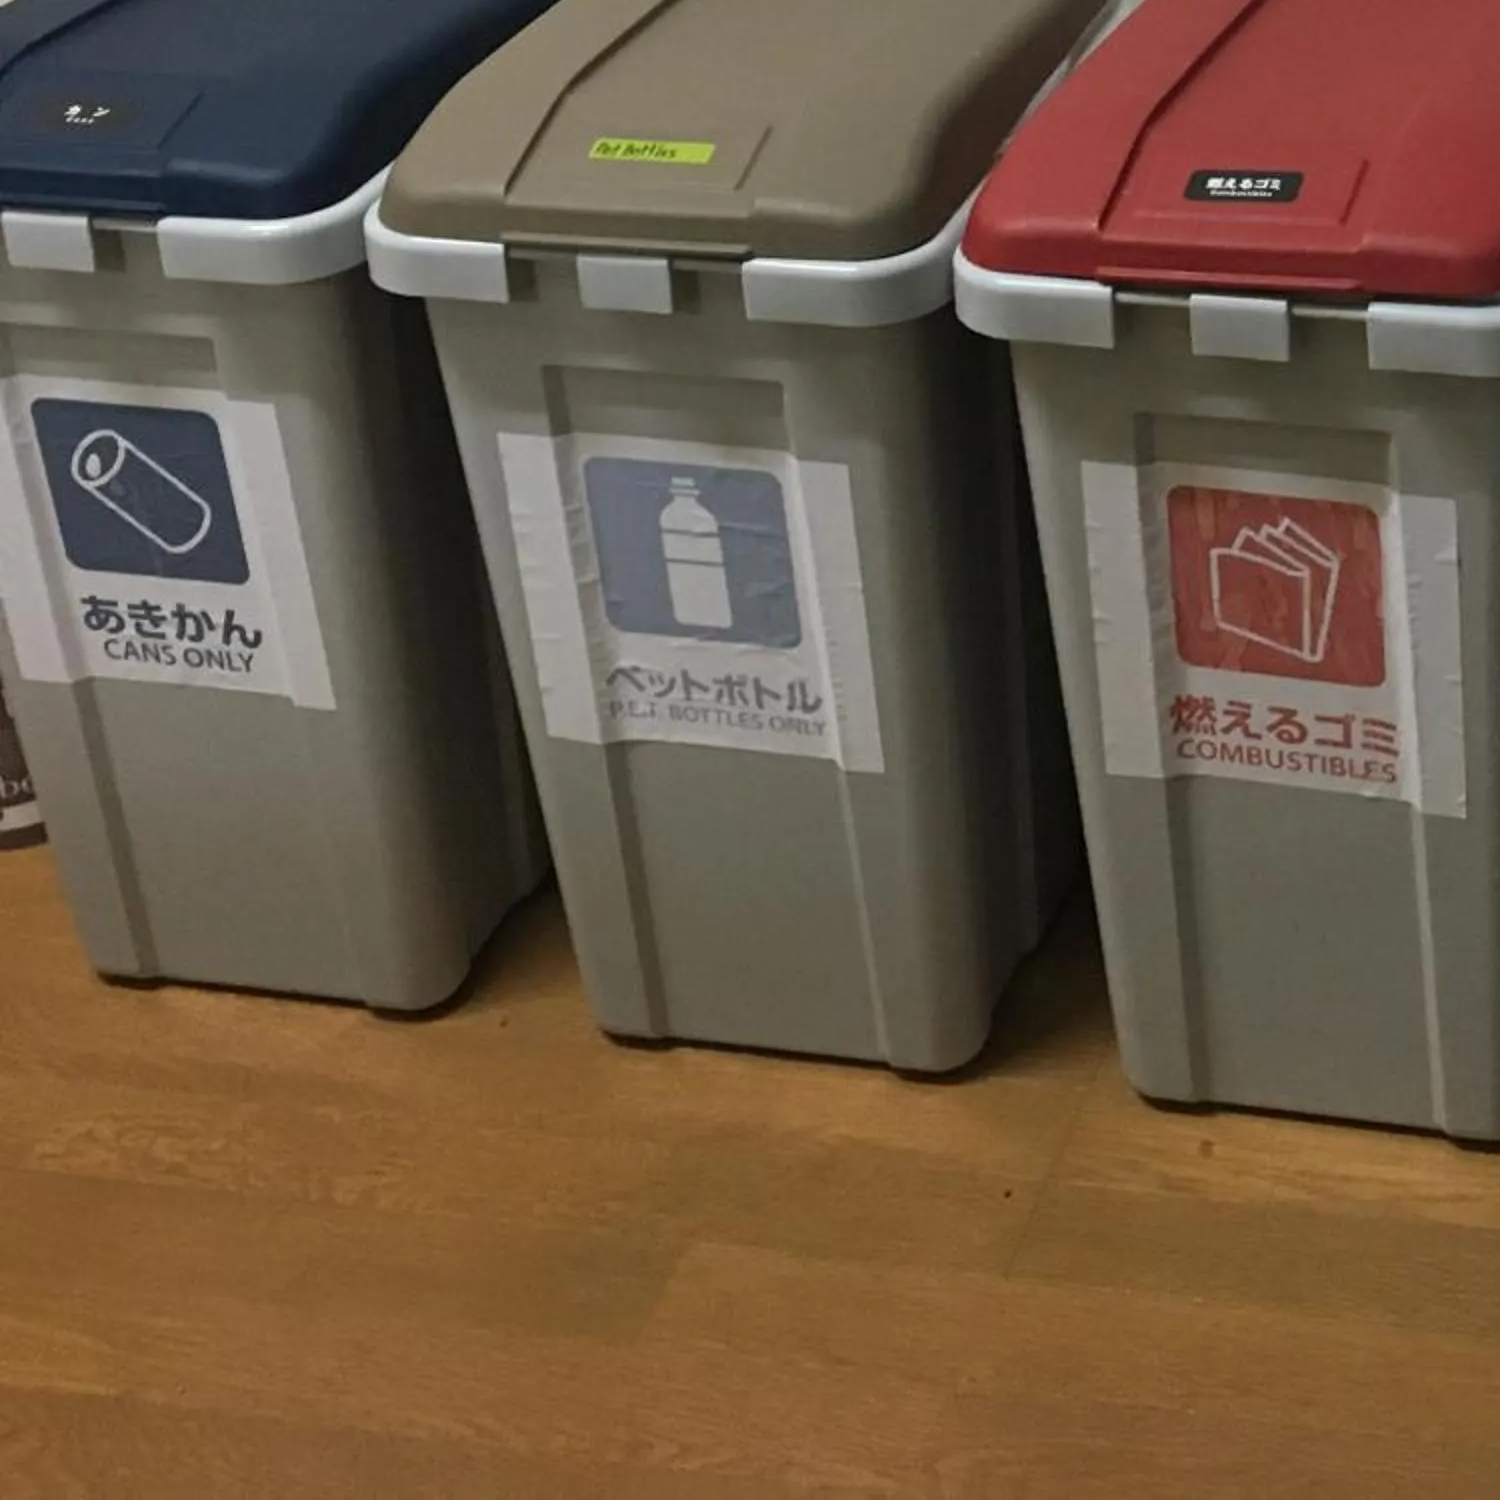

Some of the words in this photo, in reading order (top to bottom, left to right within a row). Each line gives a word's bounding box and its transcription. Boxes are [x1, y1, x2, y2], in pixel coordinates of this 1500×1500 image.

[1206, 177, 1281, 190] 燃えるゴミ
[80, 595, 263, 649] あきかん
[103, 638, 178, 666] CANS
[183, 648, 256, 674] ONLY
[605, 663, 824, 715] ペットボトル
[669, 702, 764, 731] BOTTLES
[768, 714, 828, 737] ONLY
[1170, 693, 1401, 758] 燃えるゴミ
[1176, 737, 1398, 784] COMBUSTIBLES
